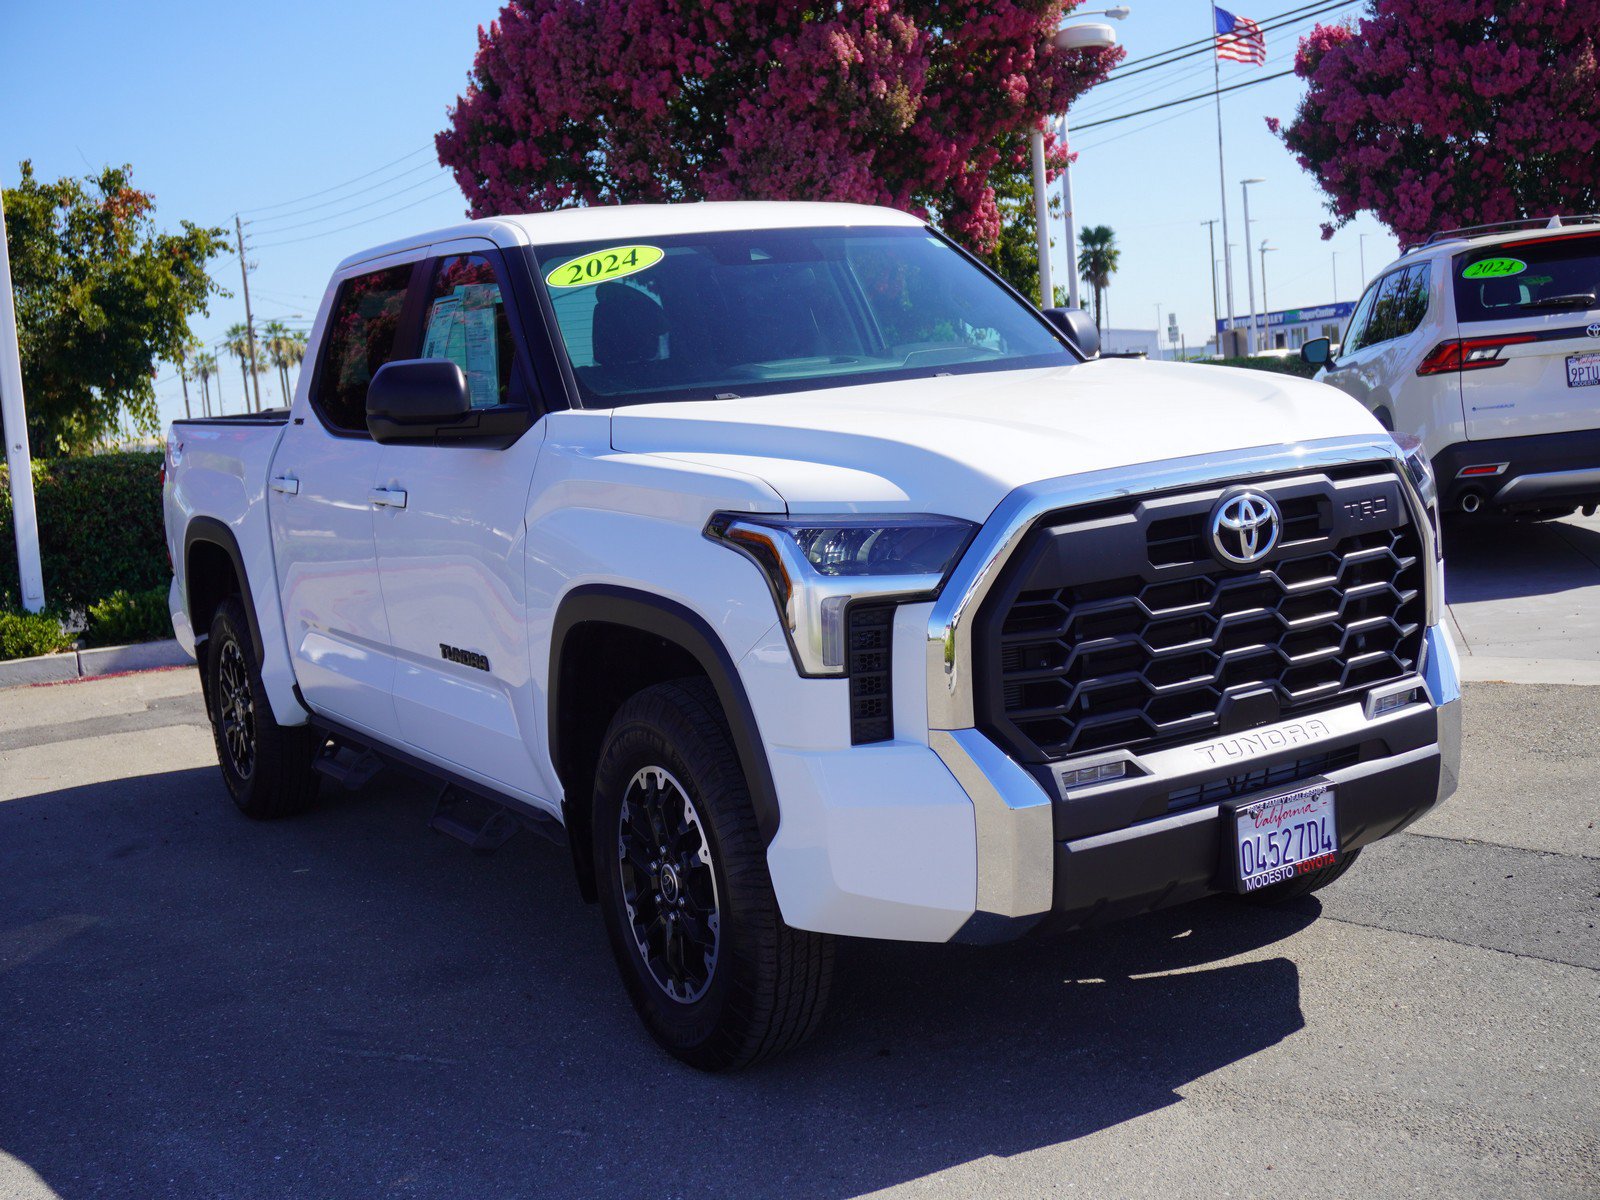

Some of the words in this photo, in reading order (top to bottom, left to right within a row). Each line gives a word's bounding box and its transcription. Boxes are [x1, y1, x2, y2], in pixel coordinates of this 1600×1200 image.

[567, 247, 638, 285] 2024
[1470, 261, 1515, 277] 2024
[1572, 379, 1599, 387] MODESTO
[439, 643, 490, 672] TUNDRA
[1193, 719, 1331, 763] TUNDRA
[1255, 799, 1318, 829] California
[1241, 817, 1333, 876] 04527D4
[1246, 866, 1294, 892] MODESTO
[1296, 853, 1336, 875] TOYOTA
